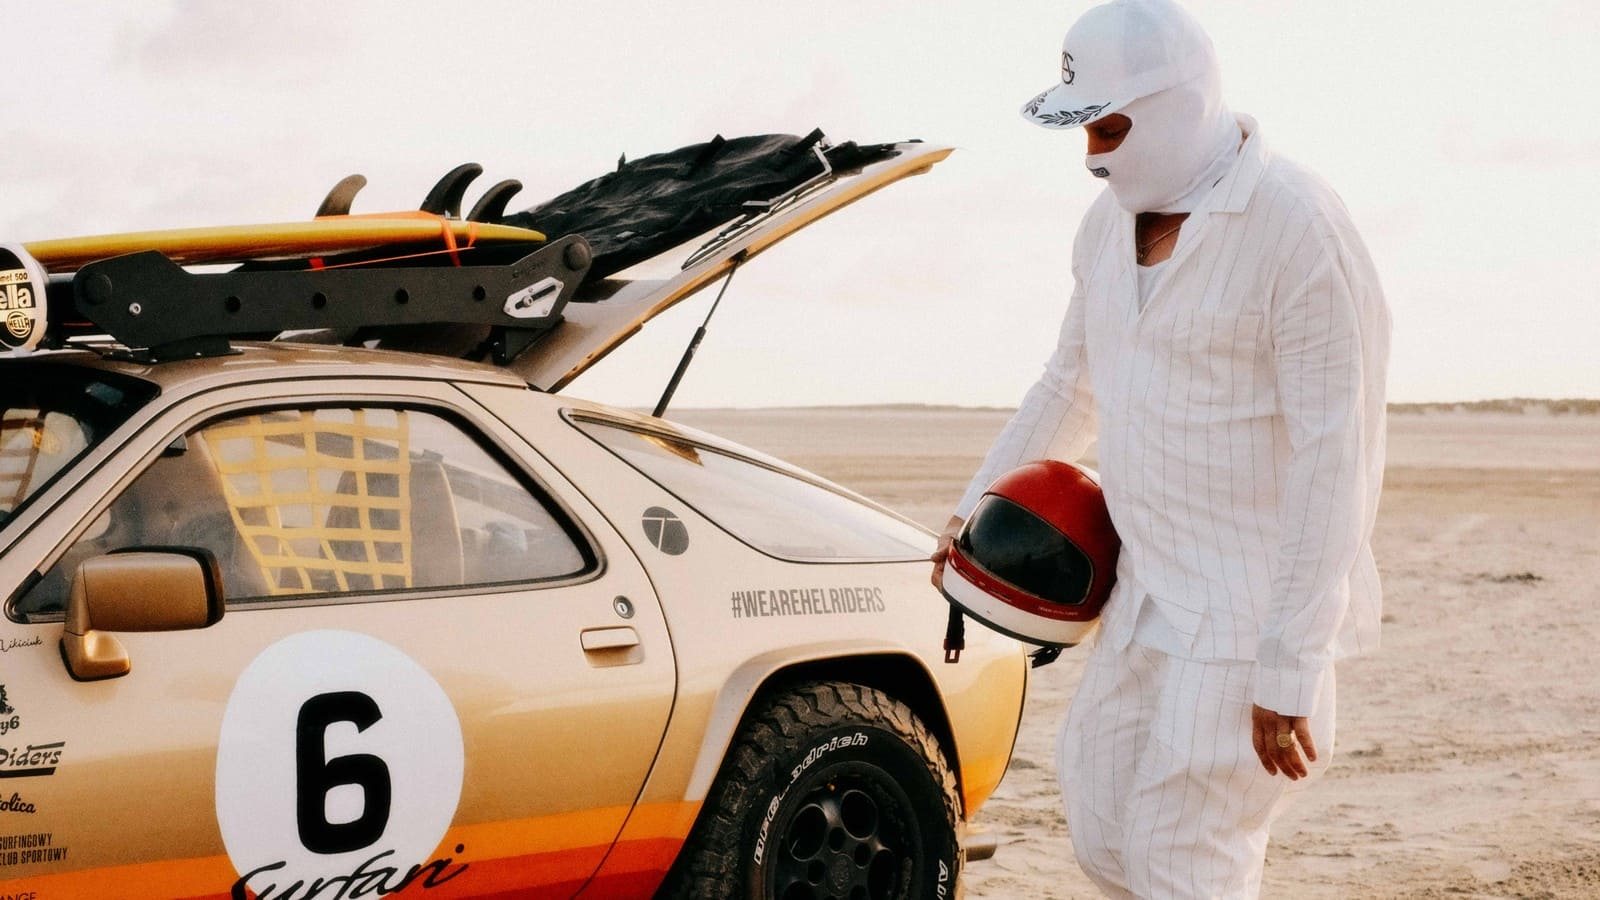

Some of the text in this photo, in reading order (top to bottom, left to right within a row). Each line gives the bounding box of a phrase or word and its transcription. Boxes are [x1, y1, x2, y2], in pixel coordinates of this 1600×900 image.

[15, 272, 28, 281] 500
[9, 317, 30, 329] HELLA
[731, 587, 886, 618] #WEAREHELRIDERS
[296, 690, 391, 855] 6
[0, 792, 36, 814] olica
[754, 732, 869, 865] BFGodrich
[20, 847, 67, 864] SPORTOWY
[231, 843, 469, 900] Surfari
